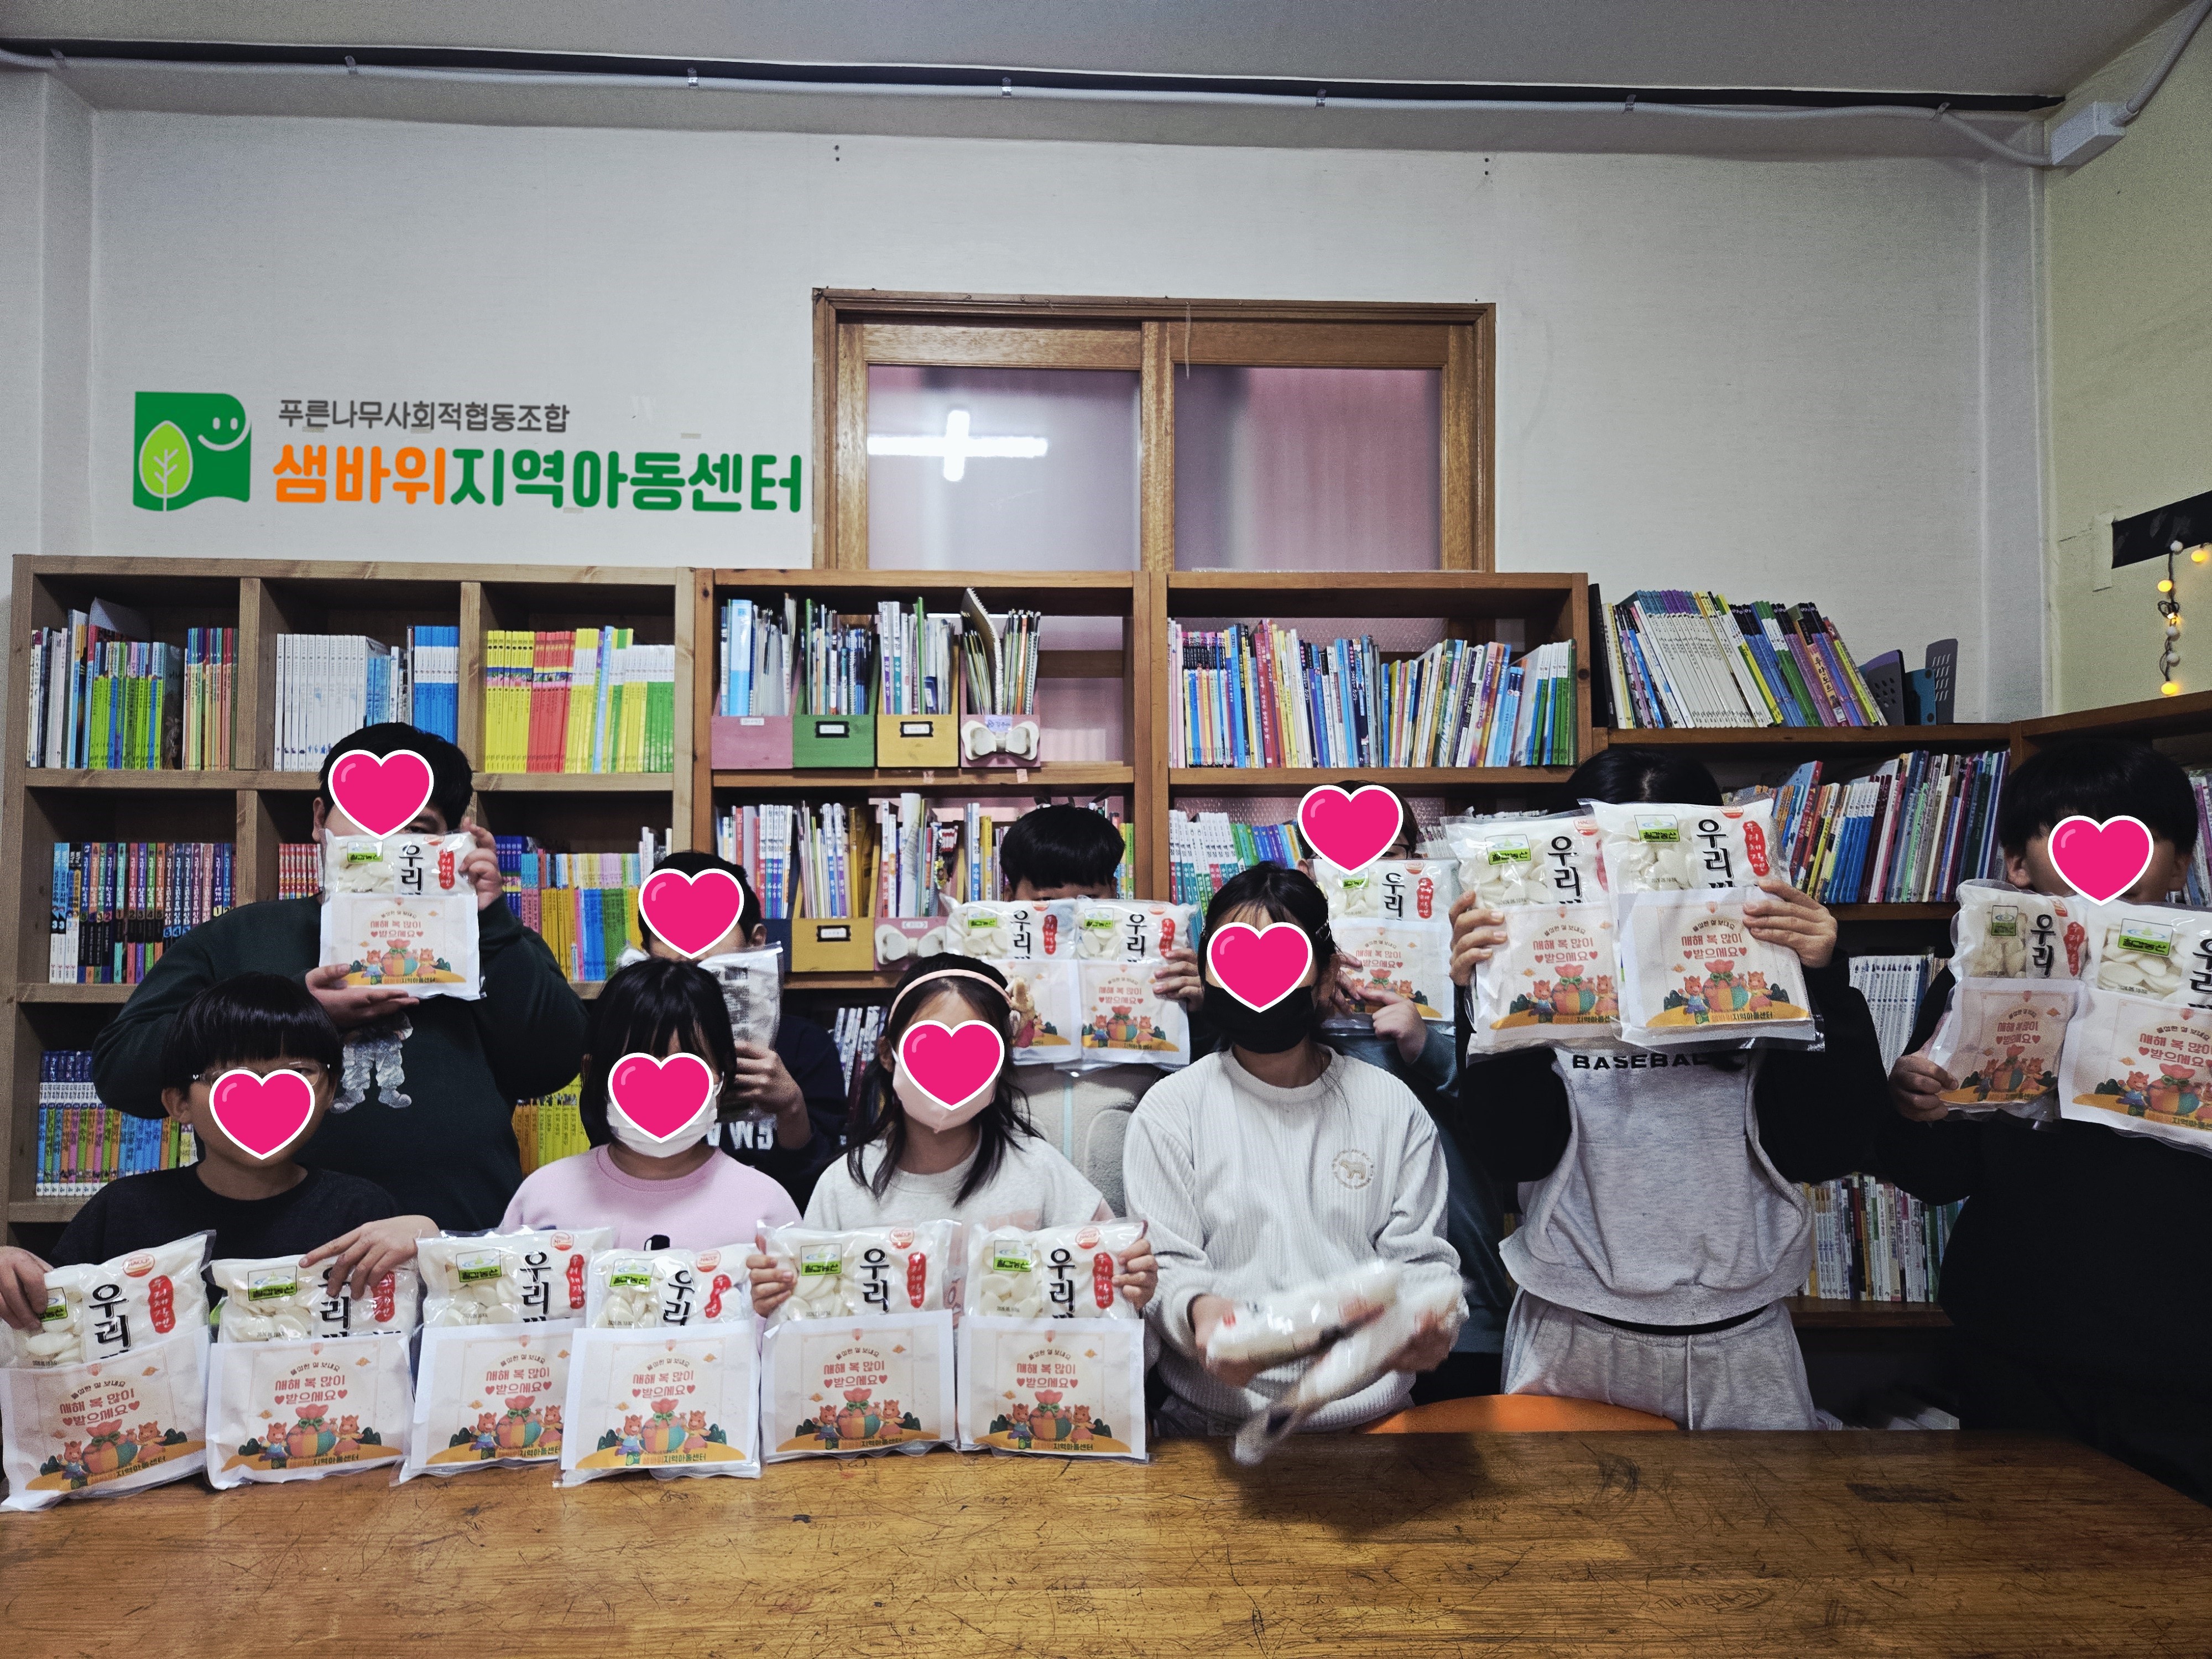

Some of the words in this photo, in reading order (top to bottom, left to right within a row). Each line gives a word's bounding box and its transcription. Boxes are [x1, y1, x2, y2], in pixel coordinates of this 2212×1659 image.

[279, 398, 570, 432] 푸른나무사회적협동조합
[272, 444, 802, 513] 샘바위지역아동센터
[1697, 820, 1734, 878] 우리
[399, 845, 424, 892] 우리
[1548, 836, 1582, 897] 우리
[1382, 873, 1405, 918] 우리
[1010, 910, 1031, 954] 우리
[1126, 914, 1147, 957] 우리
[1682, 936, 1703, 946] 새해
[1707, 935, 1718, 945] 복
[1721, 933, 1742, 944] 많이
[1533, 940, 1554, 950] 새해
[1558, 939, 1568, 949] 복
[1571, 937, 1593, 948] 많이
[1693, 947, 1738, 959] 받으세요
[2031, 914, 2056, 977] 우리
[1545, 951, 1588, 963] 받으세요
[2140, 1033, 2166, 1047] 새해
[2171, 1040, 2184, 1050] 복
[2188, 1042, 2212, 1054] 많이
[2151, 1048, 2204, 1067] 받으세요
[520, 1251, 553, 1314] 우리
[860, 1248, 890, 1313] 우리
[1047, 1248, 1076, 1312] 우리
[663, 1270, 695, 1326] 우리
[89, 1284, 129, 1348] 우리
[486, 1370, 509, 1381] 새해
[514, 1369, 524, 1379] 복
[529, 1367, 549, 1379] 많이
[633, 1374, 655, 1384] 새해
[659, 1373, 669, 1383] 복
[672, 1370, 693, 1382] 많이
[824, 1363, 845, 1375] 새해
[849, 1362, 859, 1372] 복
[863, 1360, 884, 1371] 많이
[1017, 1363, 1037, 1374] 새해
[1041, 1364, 1051, 1374] 복
[1055, 1364, 1076, 1374] 많이
[275, 1379, 300, 1391] 새해
[305, 1378, 316, 1388] 복
[321, 1375, 345, 1387] 많이
[497, 1382, 541, 1395] 받으세요
[643, 1385, 685, 1398] 받으세요
[834, 1375, 878, 1387] 받으세요
[1026, 1378, 1068, 1388] 받으세요
[60, 1402, 85, 1413] 새해
[90, 1397, 103, 1408] 복
[107, 1389, 134, 1404] 많이
[286, 1390, 336, 1405] 받으세요
[73, 1404, 128, 1426] 받으세요
